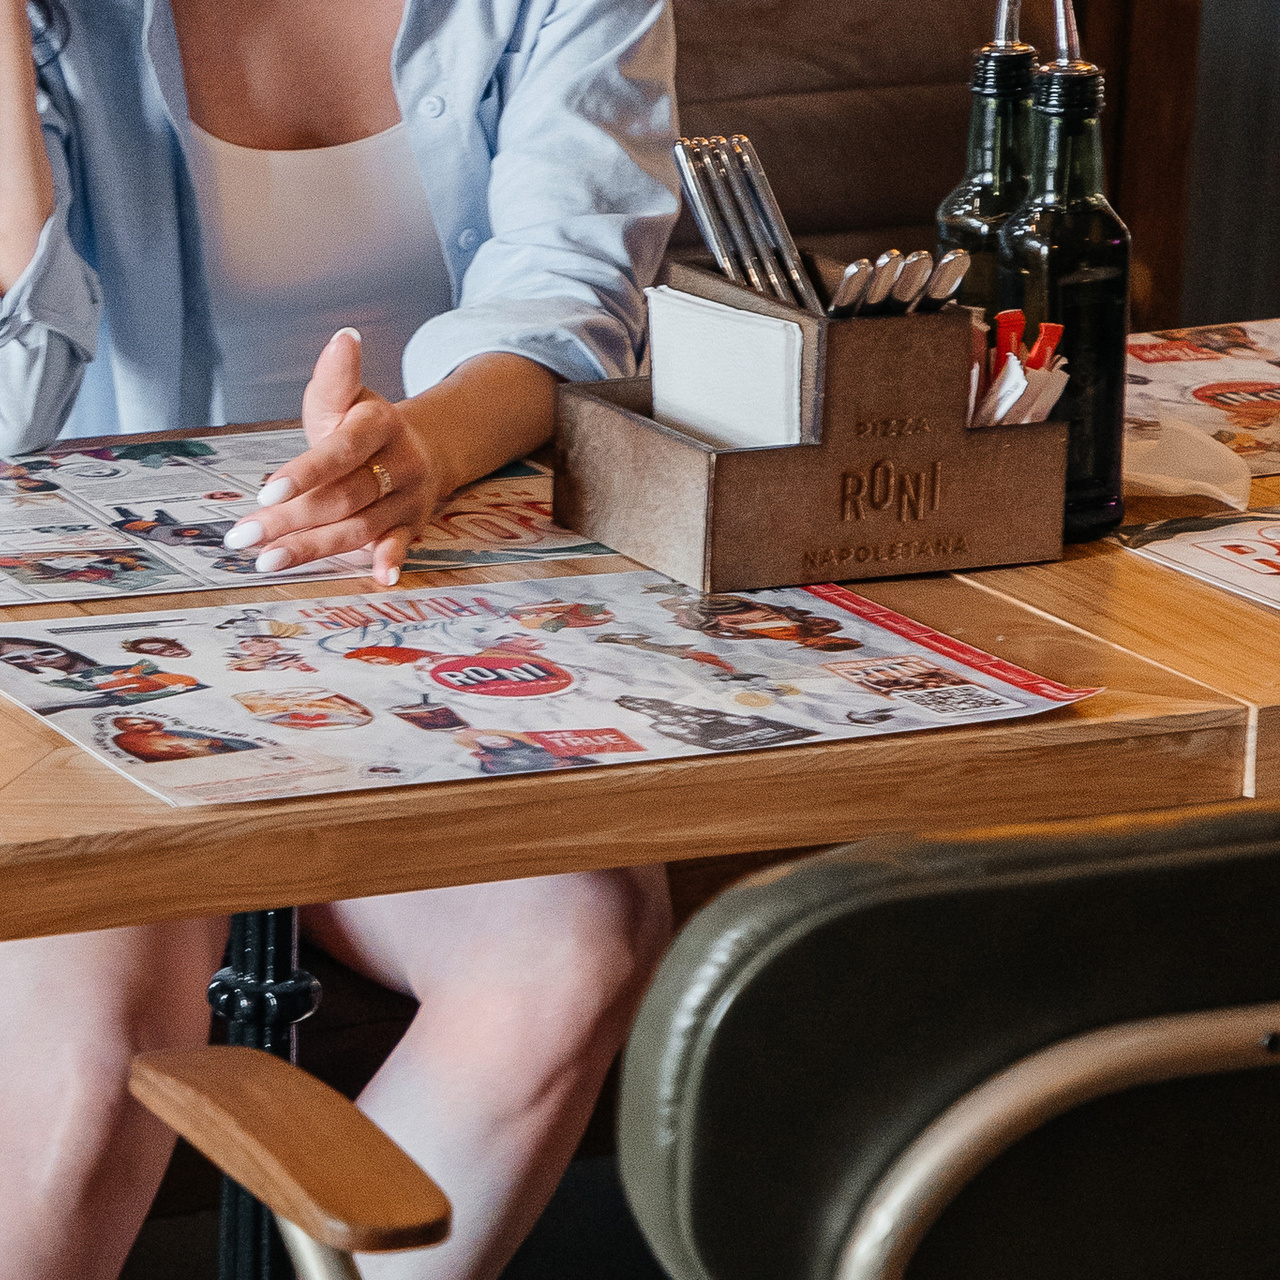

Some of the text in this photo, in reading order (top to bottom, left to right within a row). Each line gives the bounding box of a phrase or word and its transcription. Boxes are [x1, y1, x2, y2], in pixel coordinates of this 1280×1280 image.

[856, 419, 932, 438] PIZZA
[842, 458, 942, 521] RONI
[802, 535, 970, 569] NAPOLETANA
[438, 663, 550, 687] RONI
[548, 734, 627, 748] TRUE
